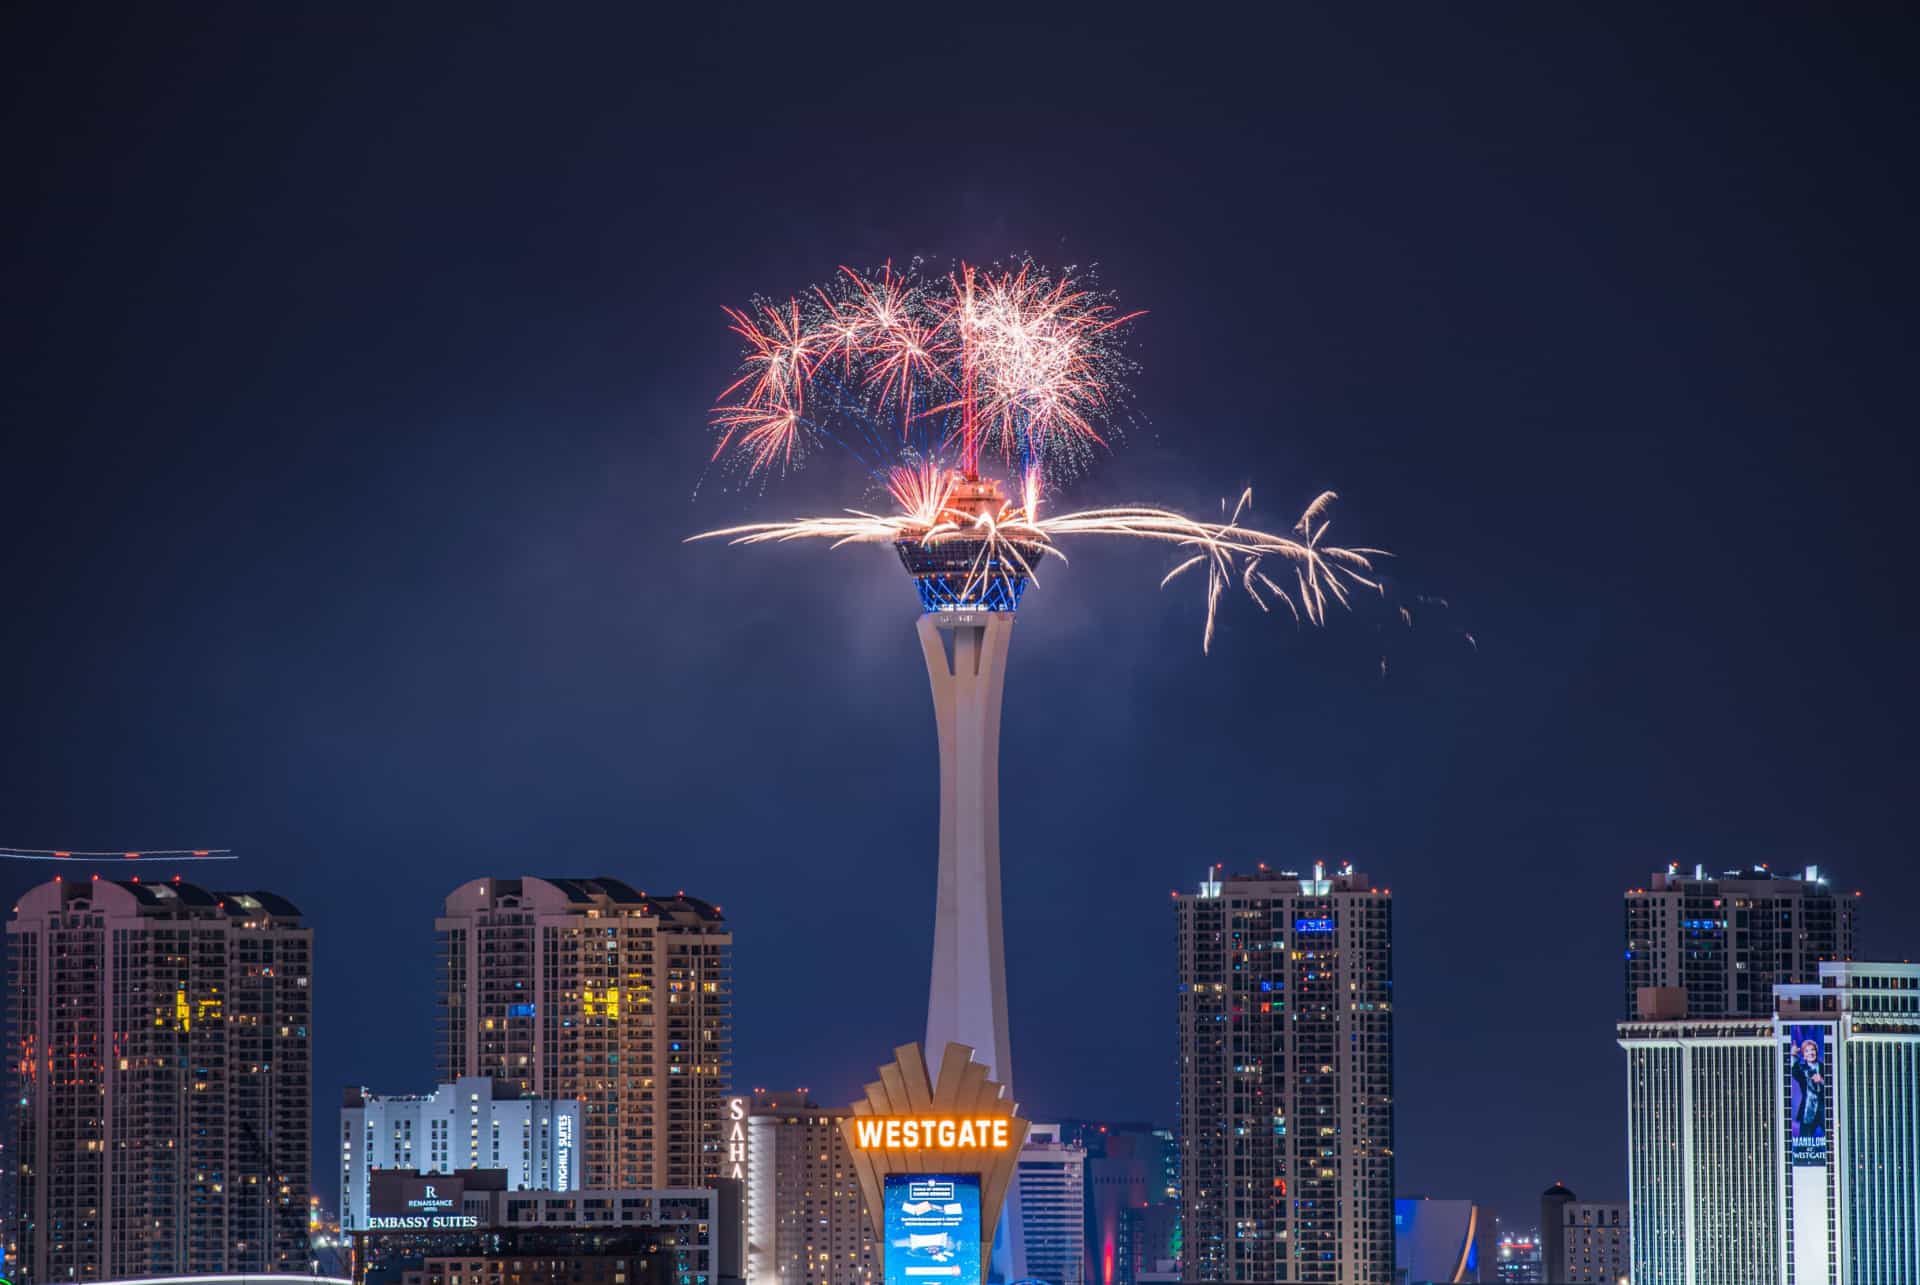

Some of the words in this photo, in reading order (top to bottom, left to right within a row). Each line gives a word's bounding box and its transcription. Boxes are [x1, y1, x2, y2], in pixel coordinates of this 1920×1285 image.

[558, 1115, 568, 1147] SUITES
[857, 1119, 1008, 1148] WESTGATE
[1792, 1136, 1826, 1147] MANILOW
[425, 1186, 438, 1198] R
[369, 1217, 430, 1228] EMBASSY
[432, 1216, 477, 1227] SUITES
